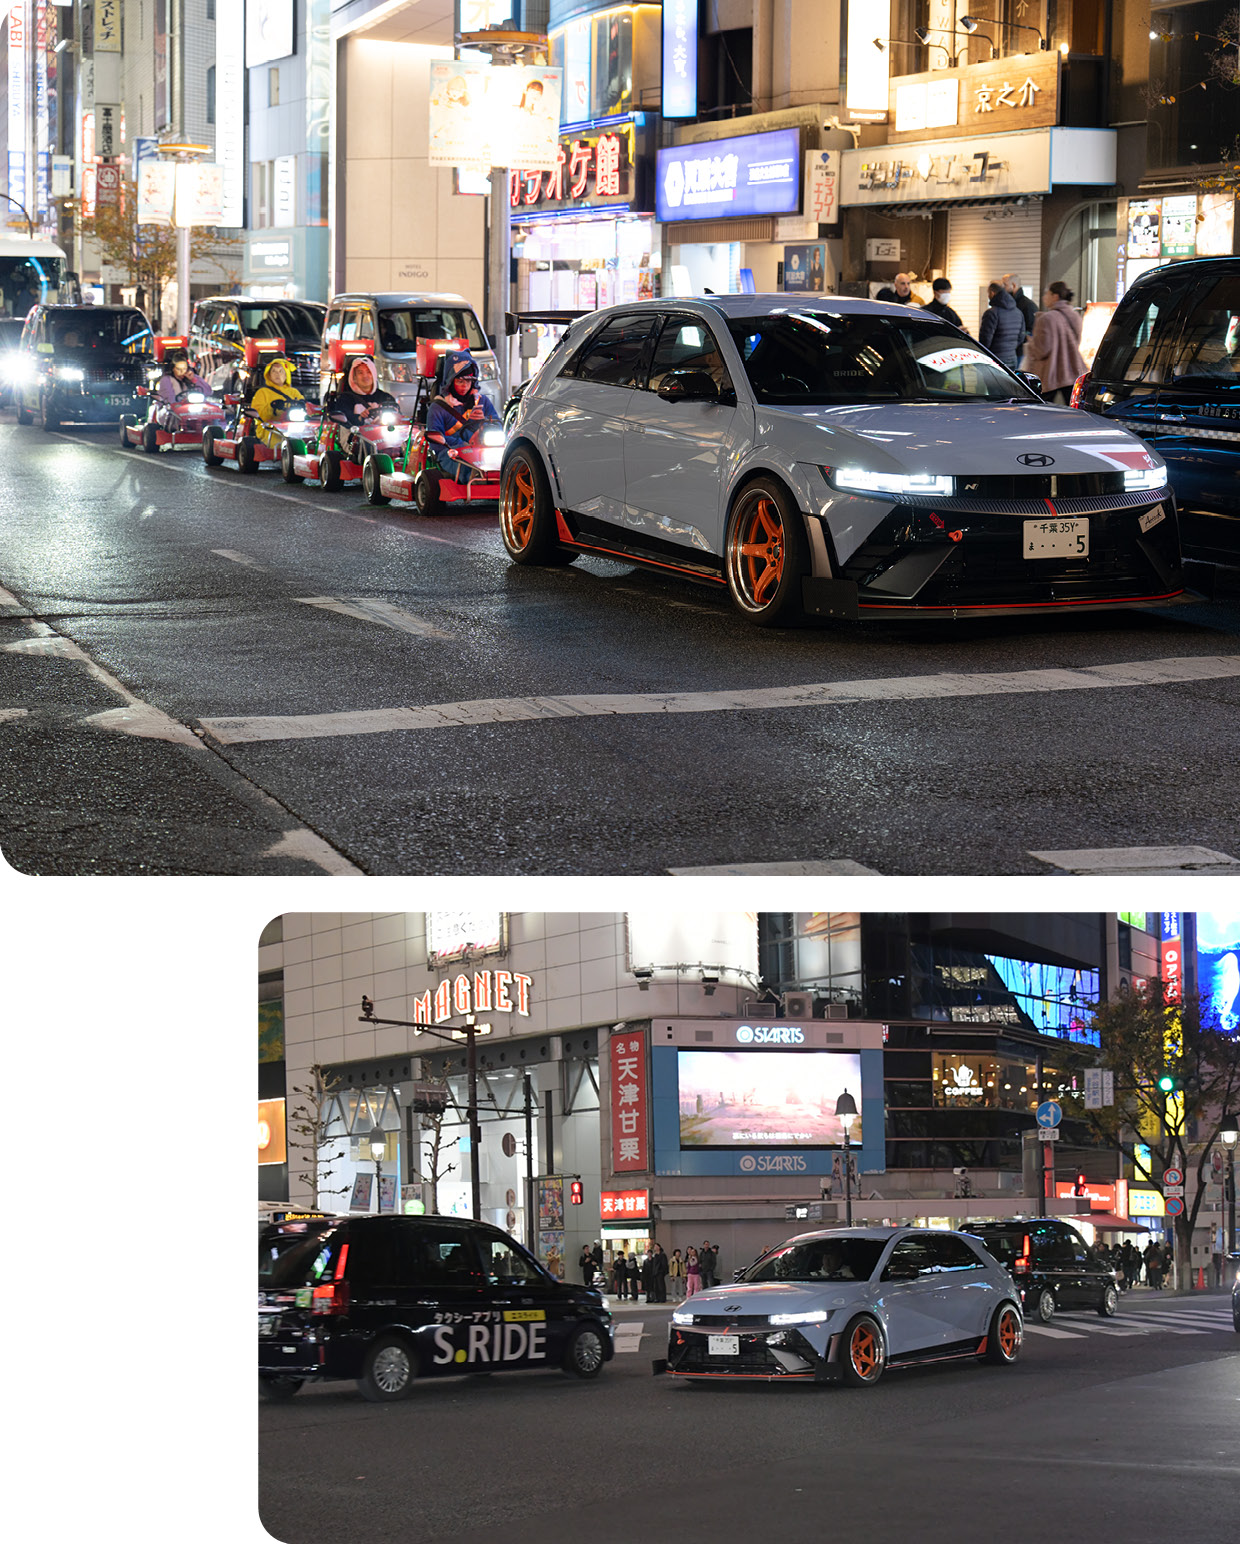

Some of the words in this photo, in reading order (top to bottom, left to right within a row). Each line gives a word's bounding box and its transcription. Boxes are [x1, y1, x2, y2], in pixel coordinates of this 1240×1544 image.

[974, 77, 1042, 114] 京之介
[1040, 523, 1058, 533] 千葉
[1060, 522, 1075, 533] 35Y
[414, 969, 532, 1036] MAGNET
[616, 1041, 640, 1054] 名物
[944, 1087, 984, 1096] COFFEE
[618, 1057, 640, 1162] 天津甘栗
[603, 1196, 646, 1213] 天津甘栗
[434, 1311, 501, 1324] タクシーアプリ
[433, 1322, 547, 1365] S.RIDE
